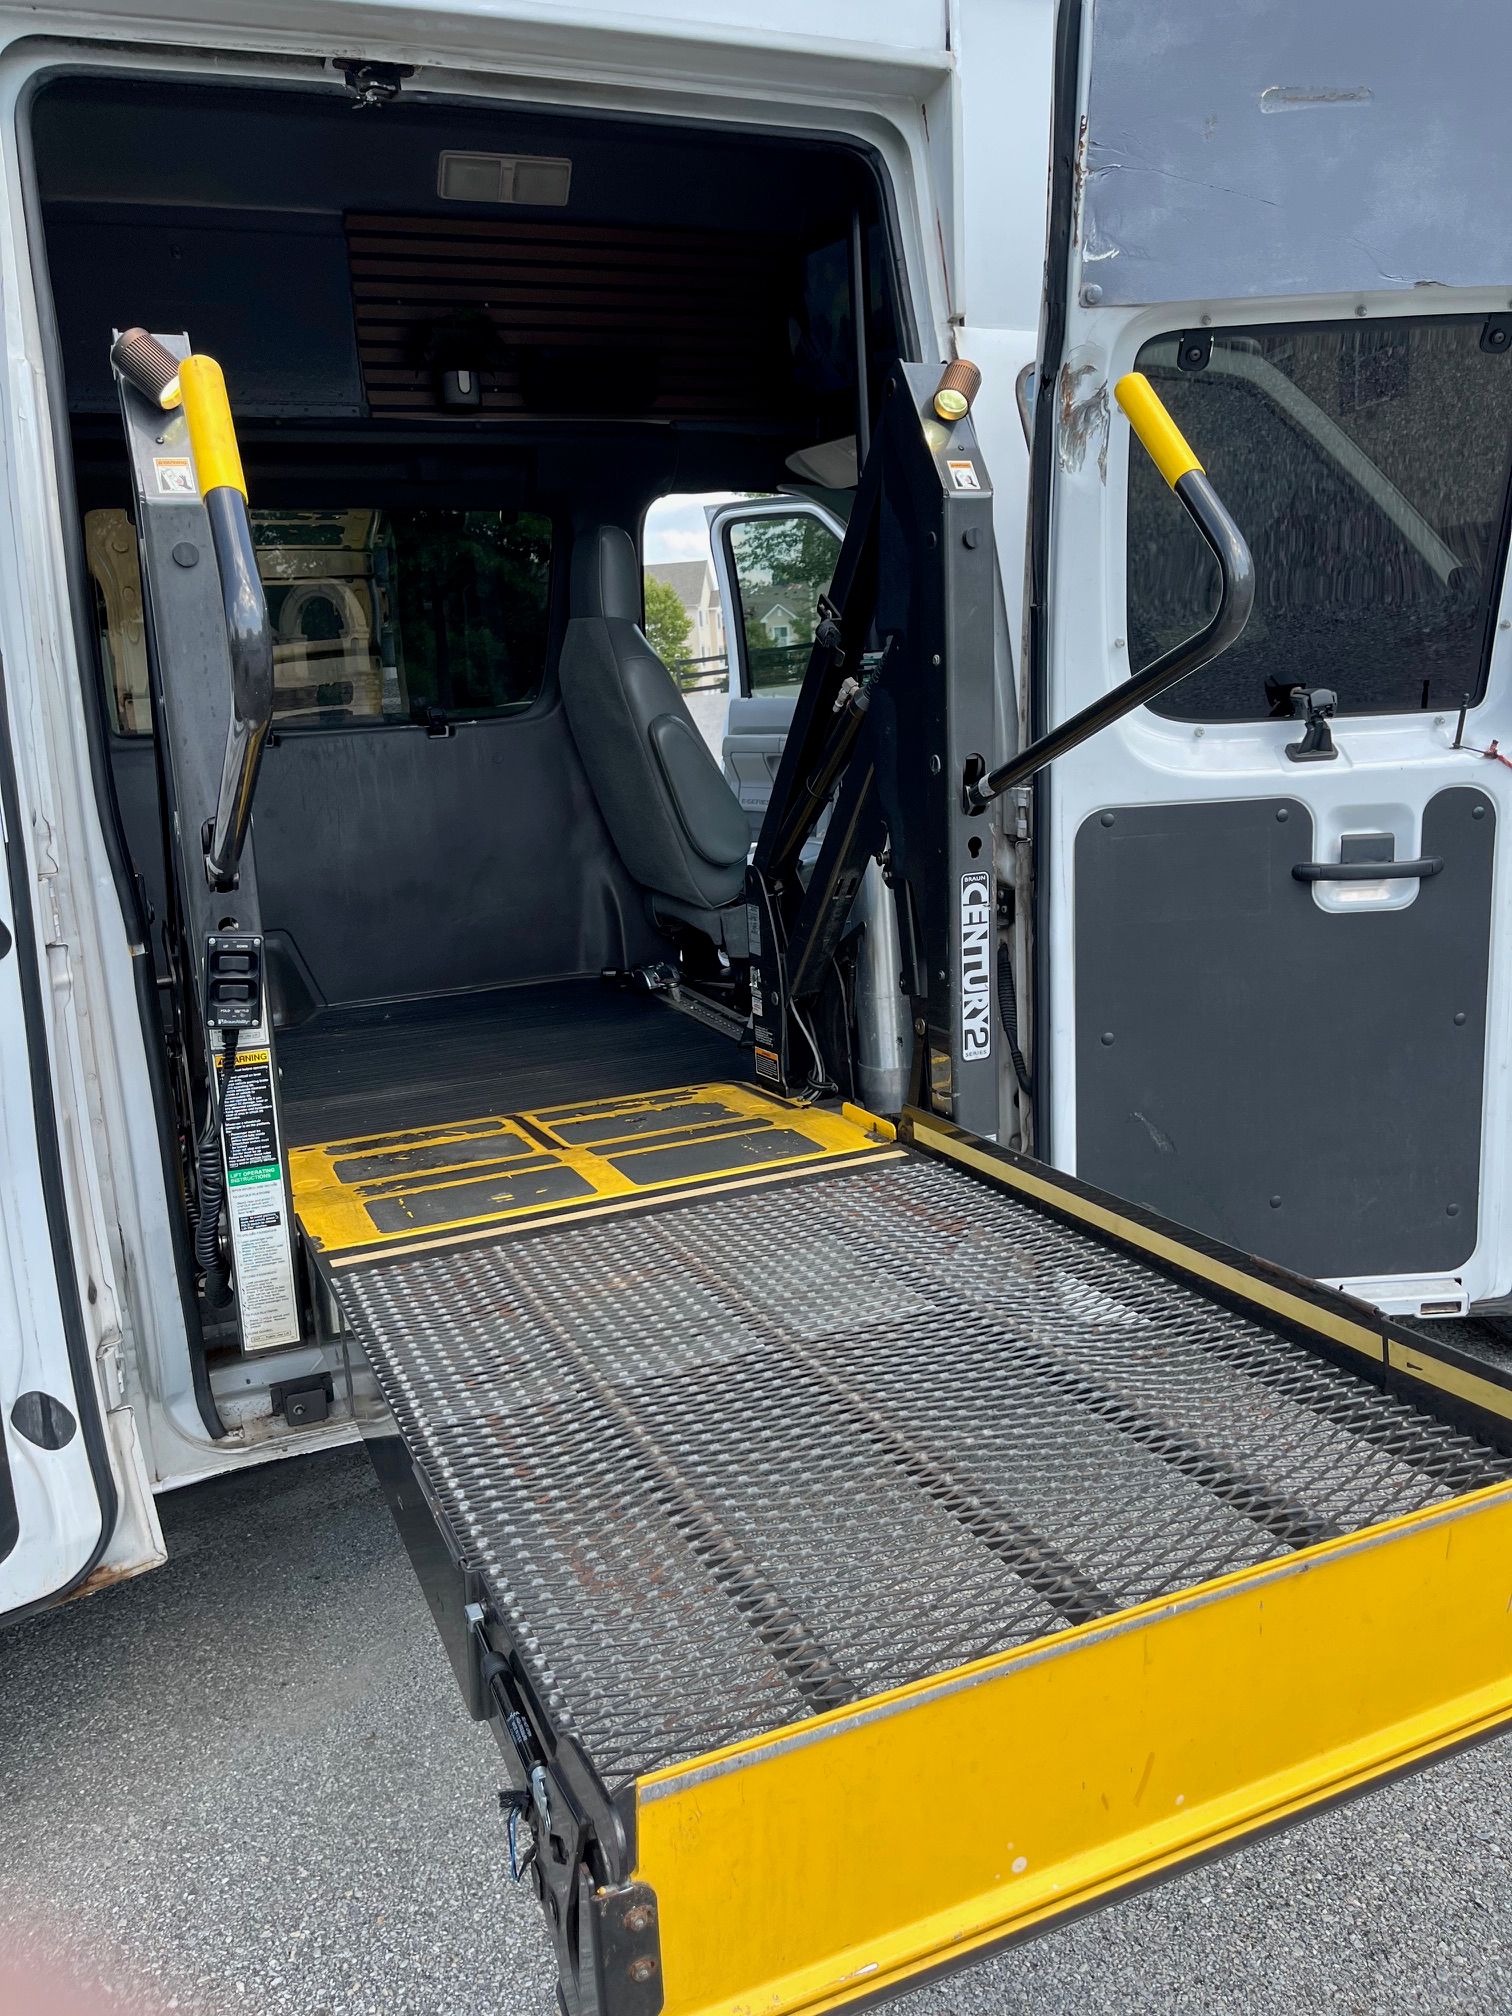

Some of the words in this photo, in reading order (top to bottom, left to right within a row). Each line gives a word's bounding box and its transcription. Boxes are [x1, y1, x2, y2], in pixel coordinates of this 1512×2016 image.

[963, 882, 989, 1027] CENTURY
[234, 1053, 268, 1064] ARNING
[242, 1167, 276, 1177] OPERATING
[230, 1173, 272, 1184] INSTRUCTIONS
